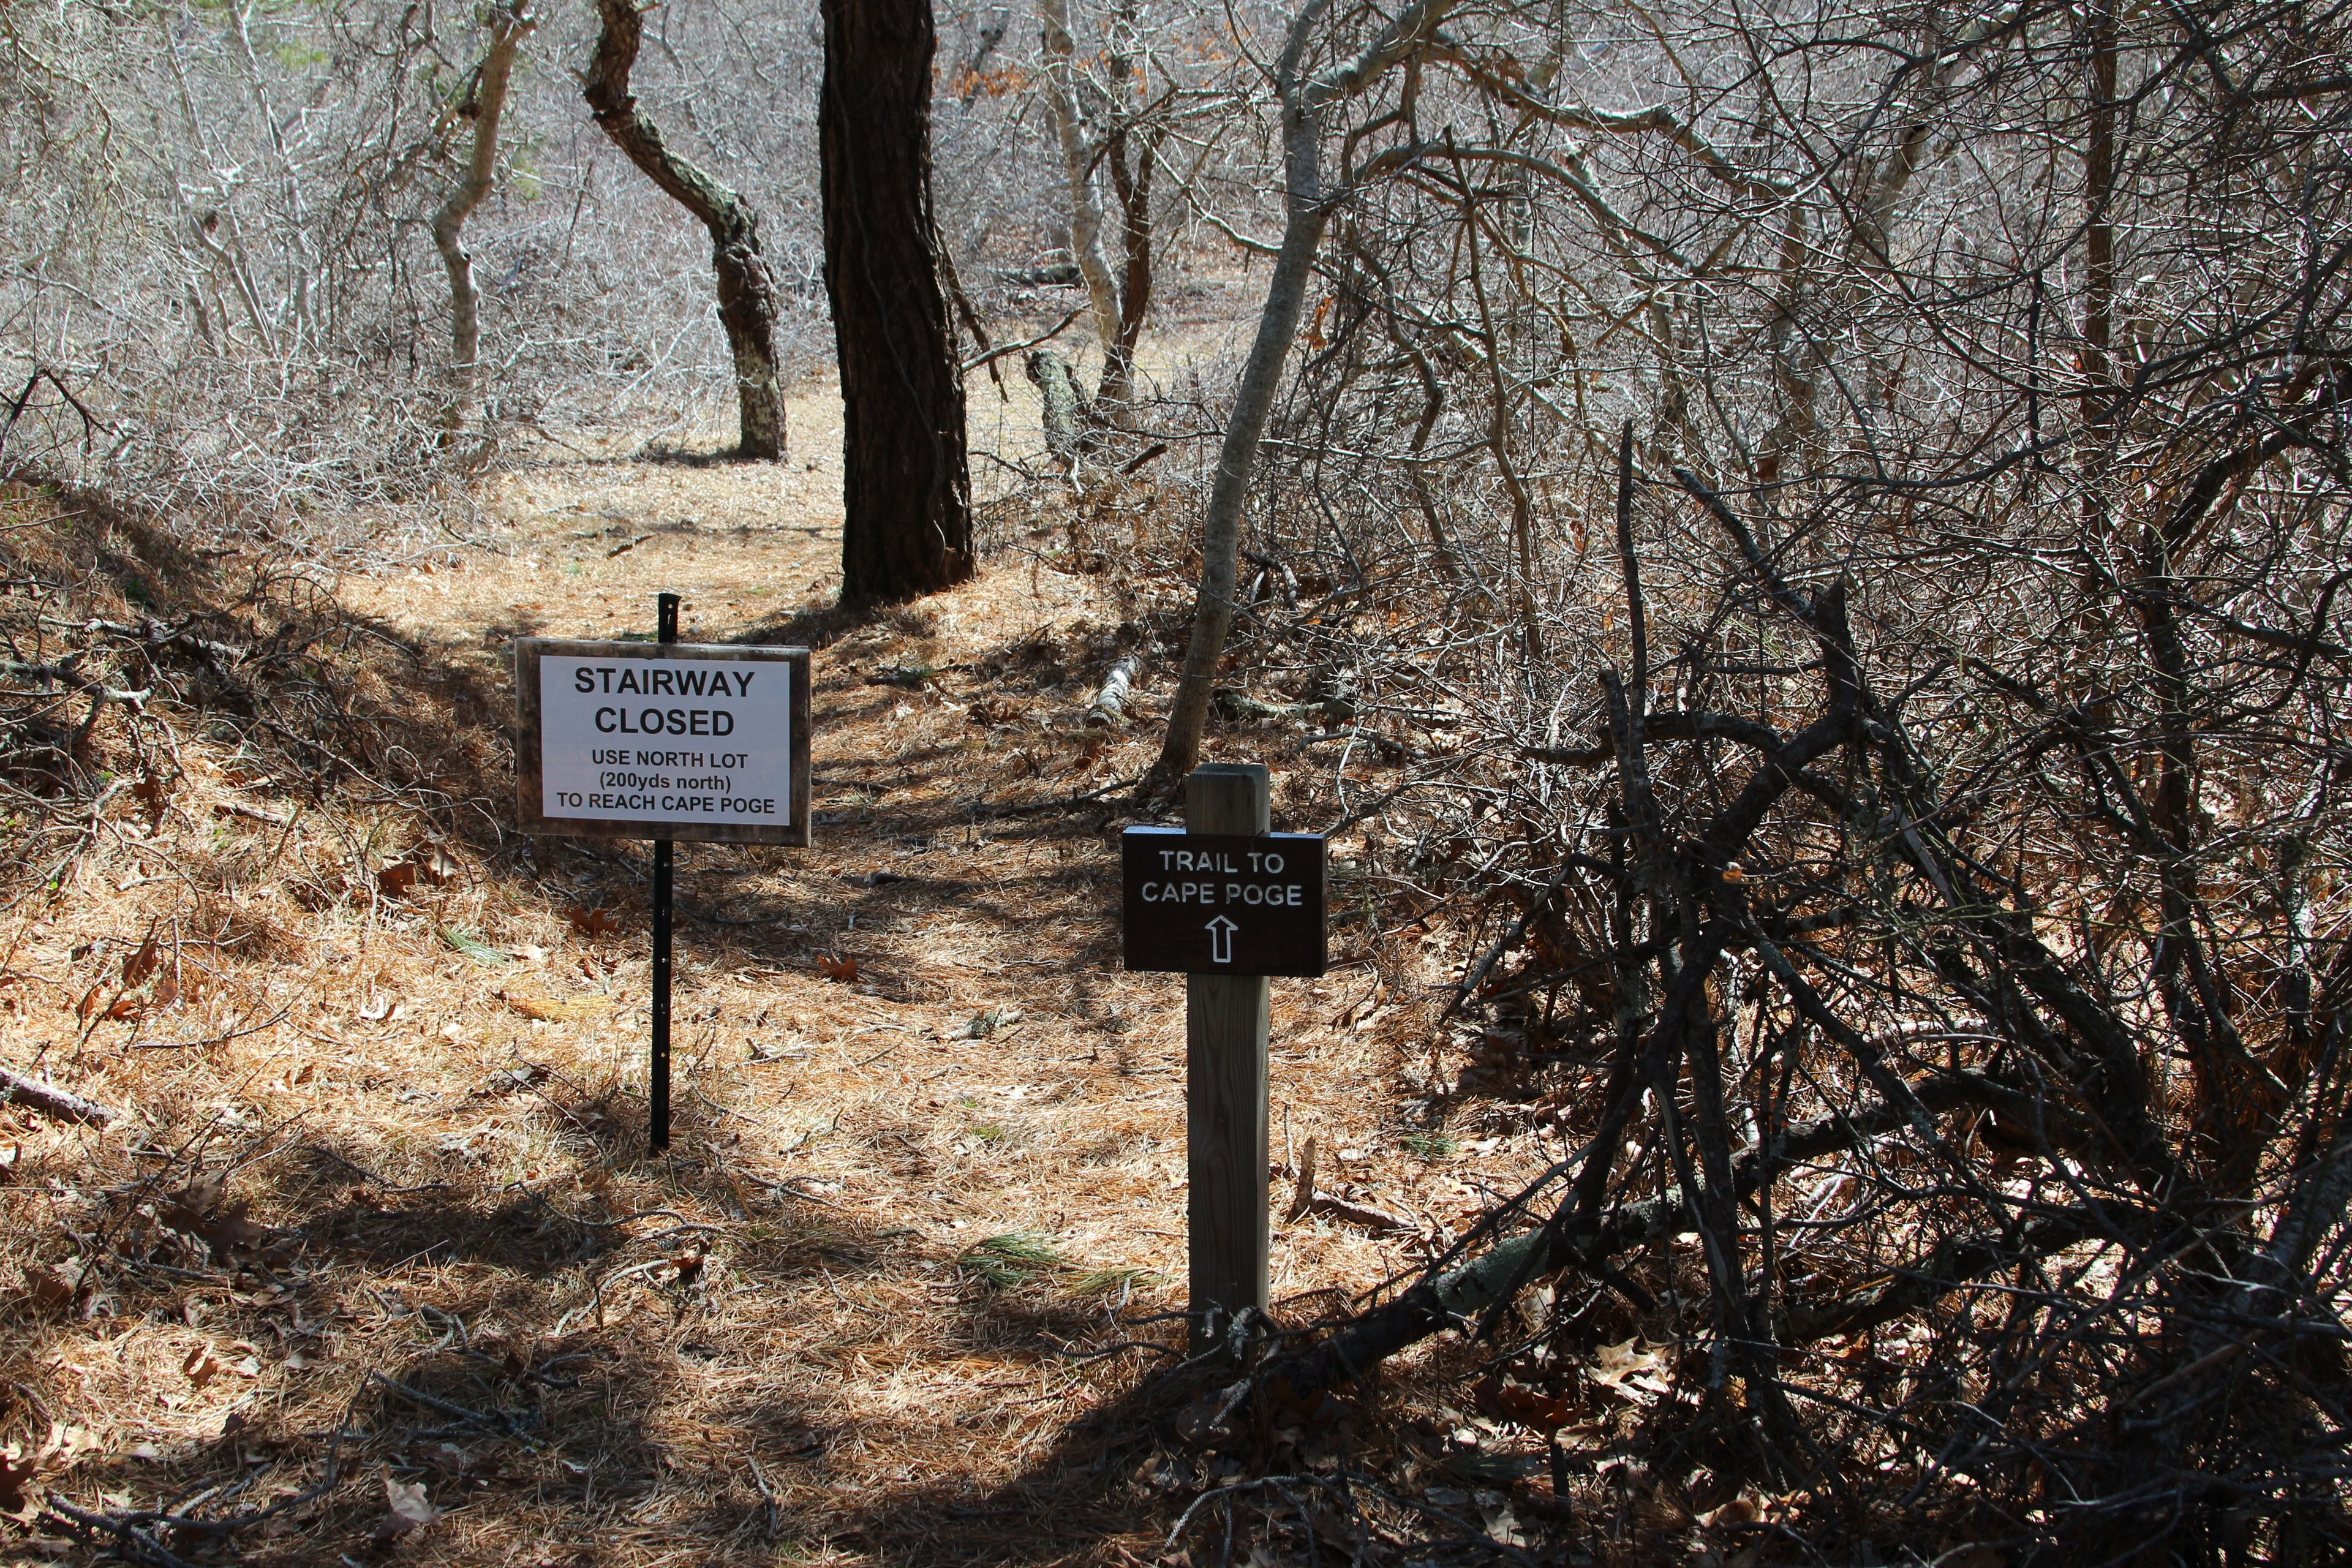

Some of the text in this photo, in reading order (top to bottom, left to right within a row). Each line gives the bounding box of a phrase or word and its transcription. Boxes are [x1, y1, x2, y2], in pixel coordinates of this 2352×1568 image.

[575, 667, 755, 697] STAIRWAY
[595, 707, 734, 736] CLOSED
[592, 750, 748, 769] USE NORTH LOT
[600, 771, 731, 794] (200yds north)
[557, 792, 775, 814] TO REACH CAPE POGE
[1159, 851, 1284, 873] TRAIL TO
[1142, 882, 1303, 906] CAPE POGE
